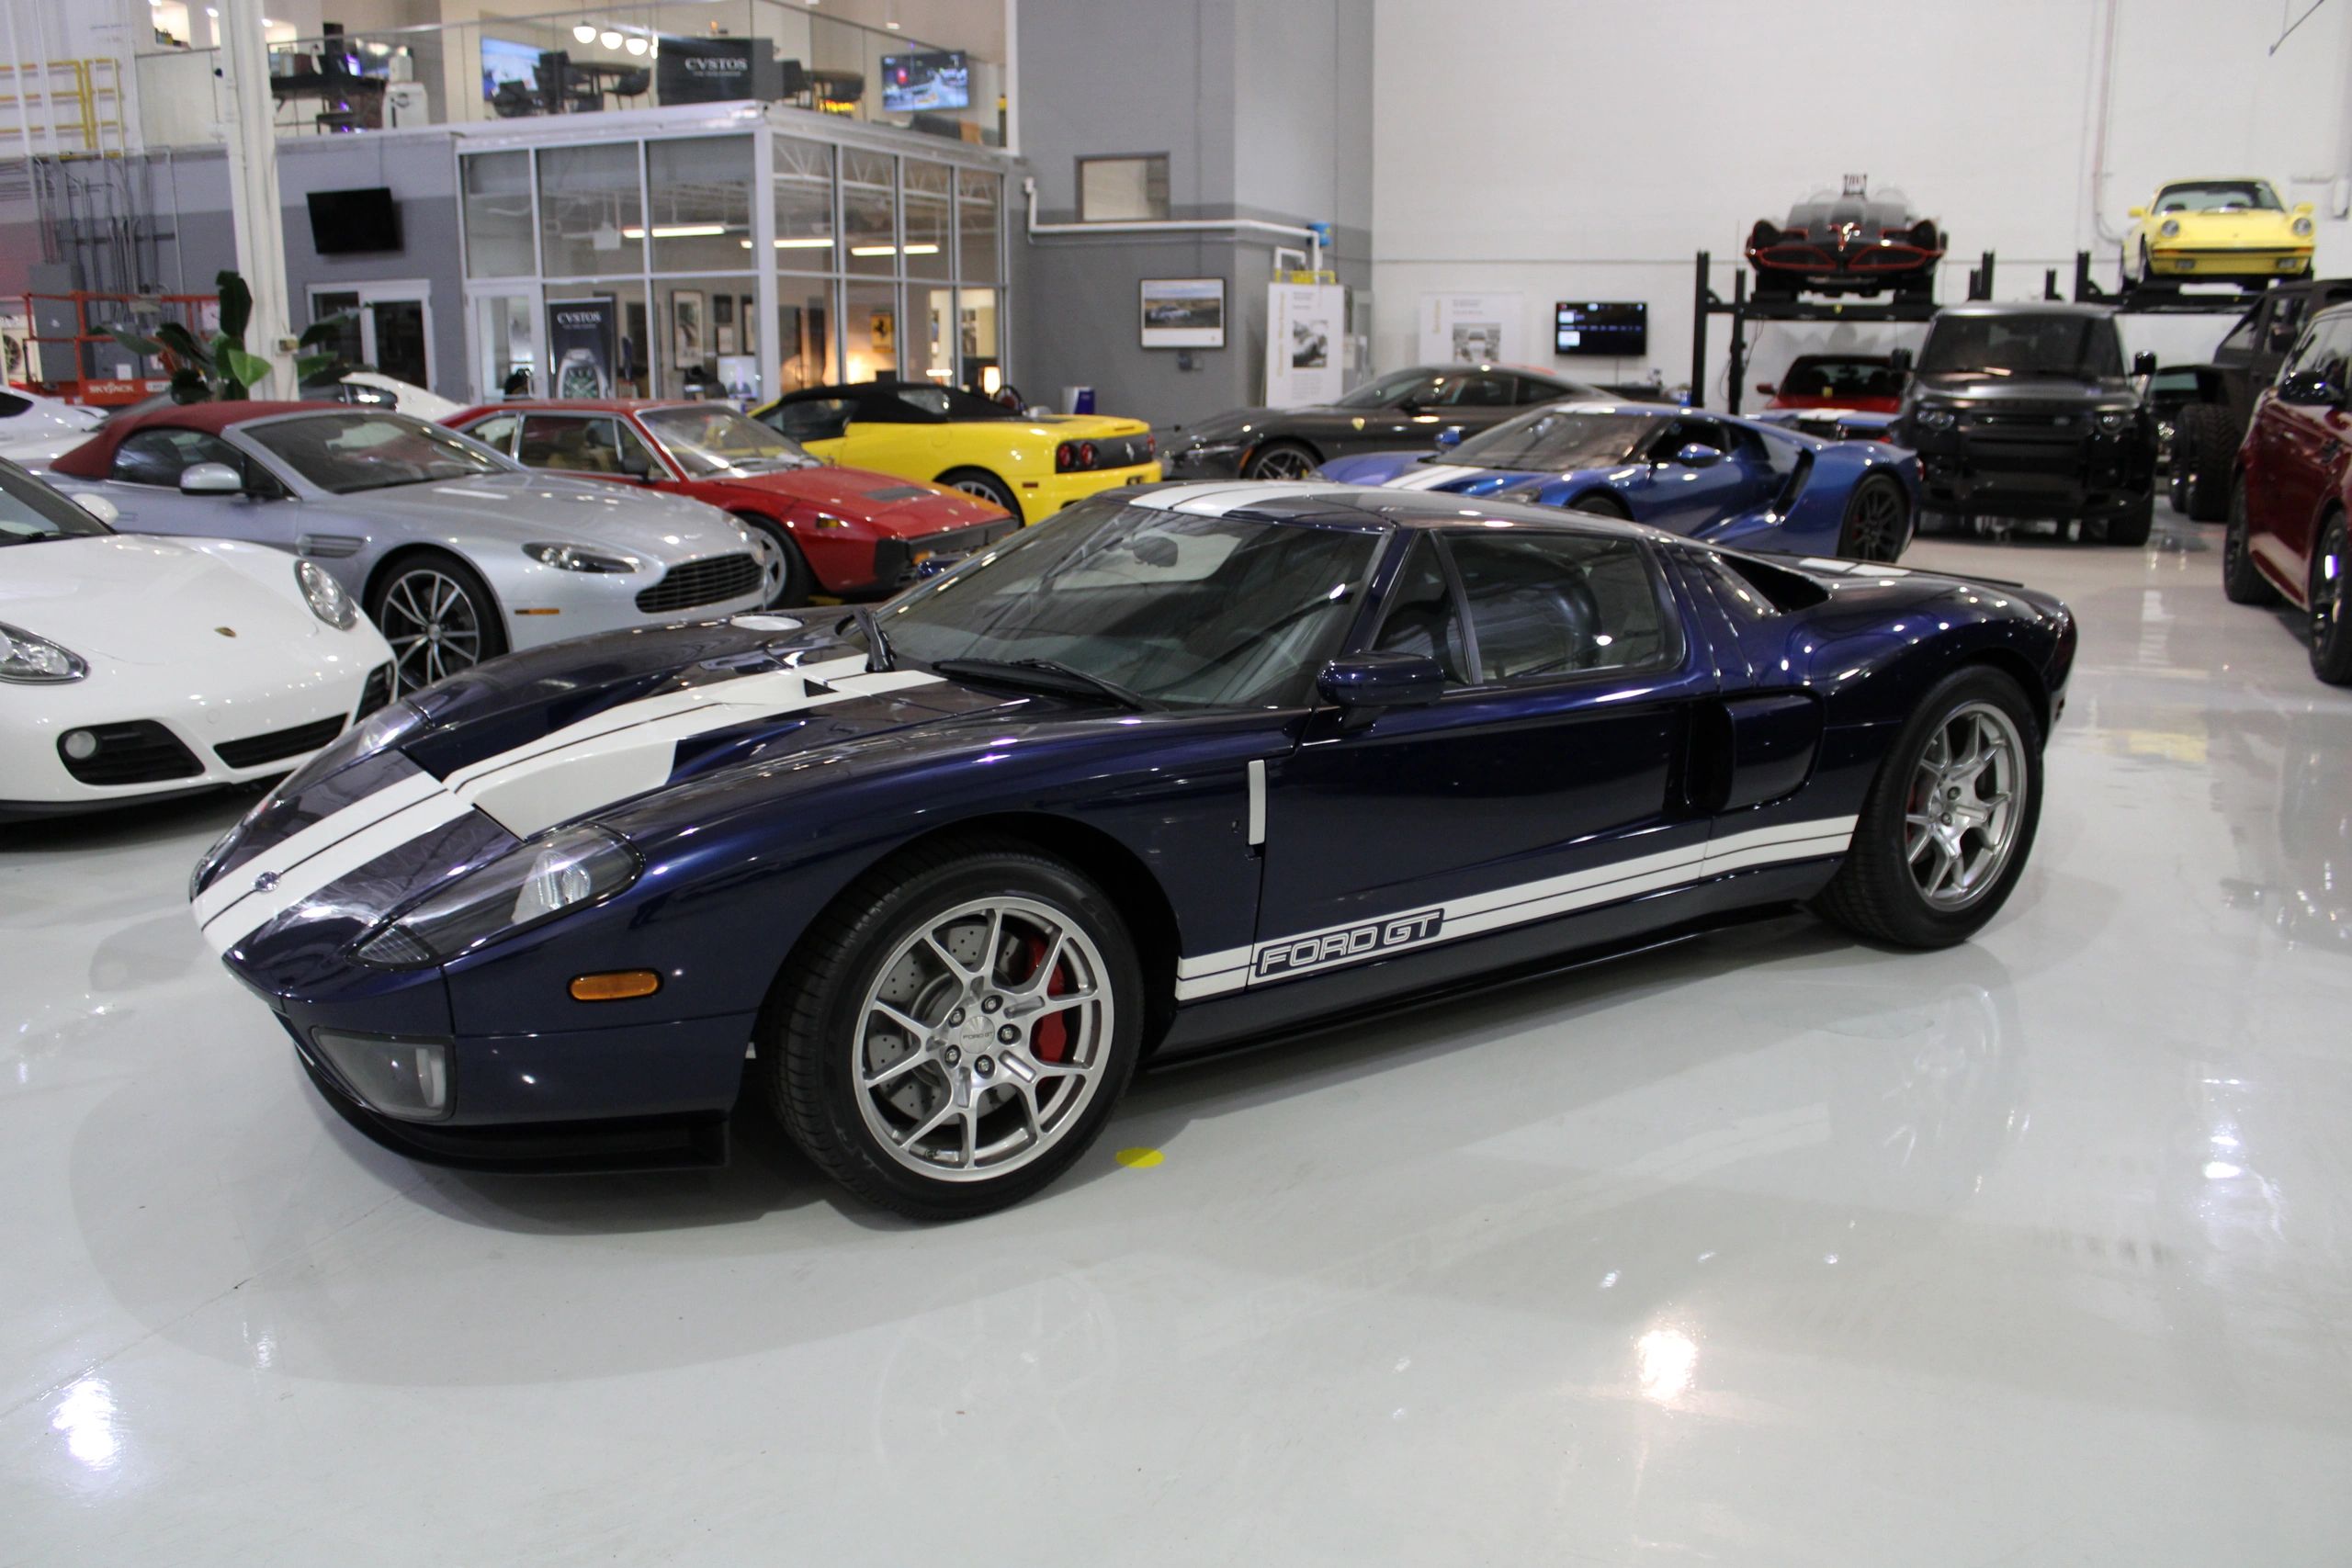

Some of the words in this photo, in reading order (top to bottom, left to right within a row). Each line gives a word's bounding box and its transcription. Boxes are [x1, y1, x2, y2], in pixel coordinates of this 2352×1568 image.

[684, 57, 749, 72] CVSTOS
[557, 311, 602, 324] CVSTOS
[1260, 926, 1379, 976] FORD
[1384, 911, 1441, 946] GT
